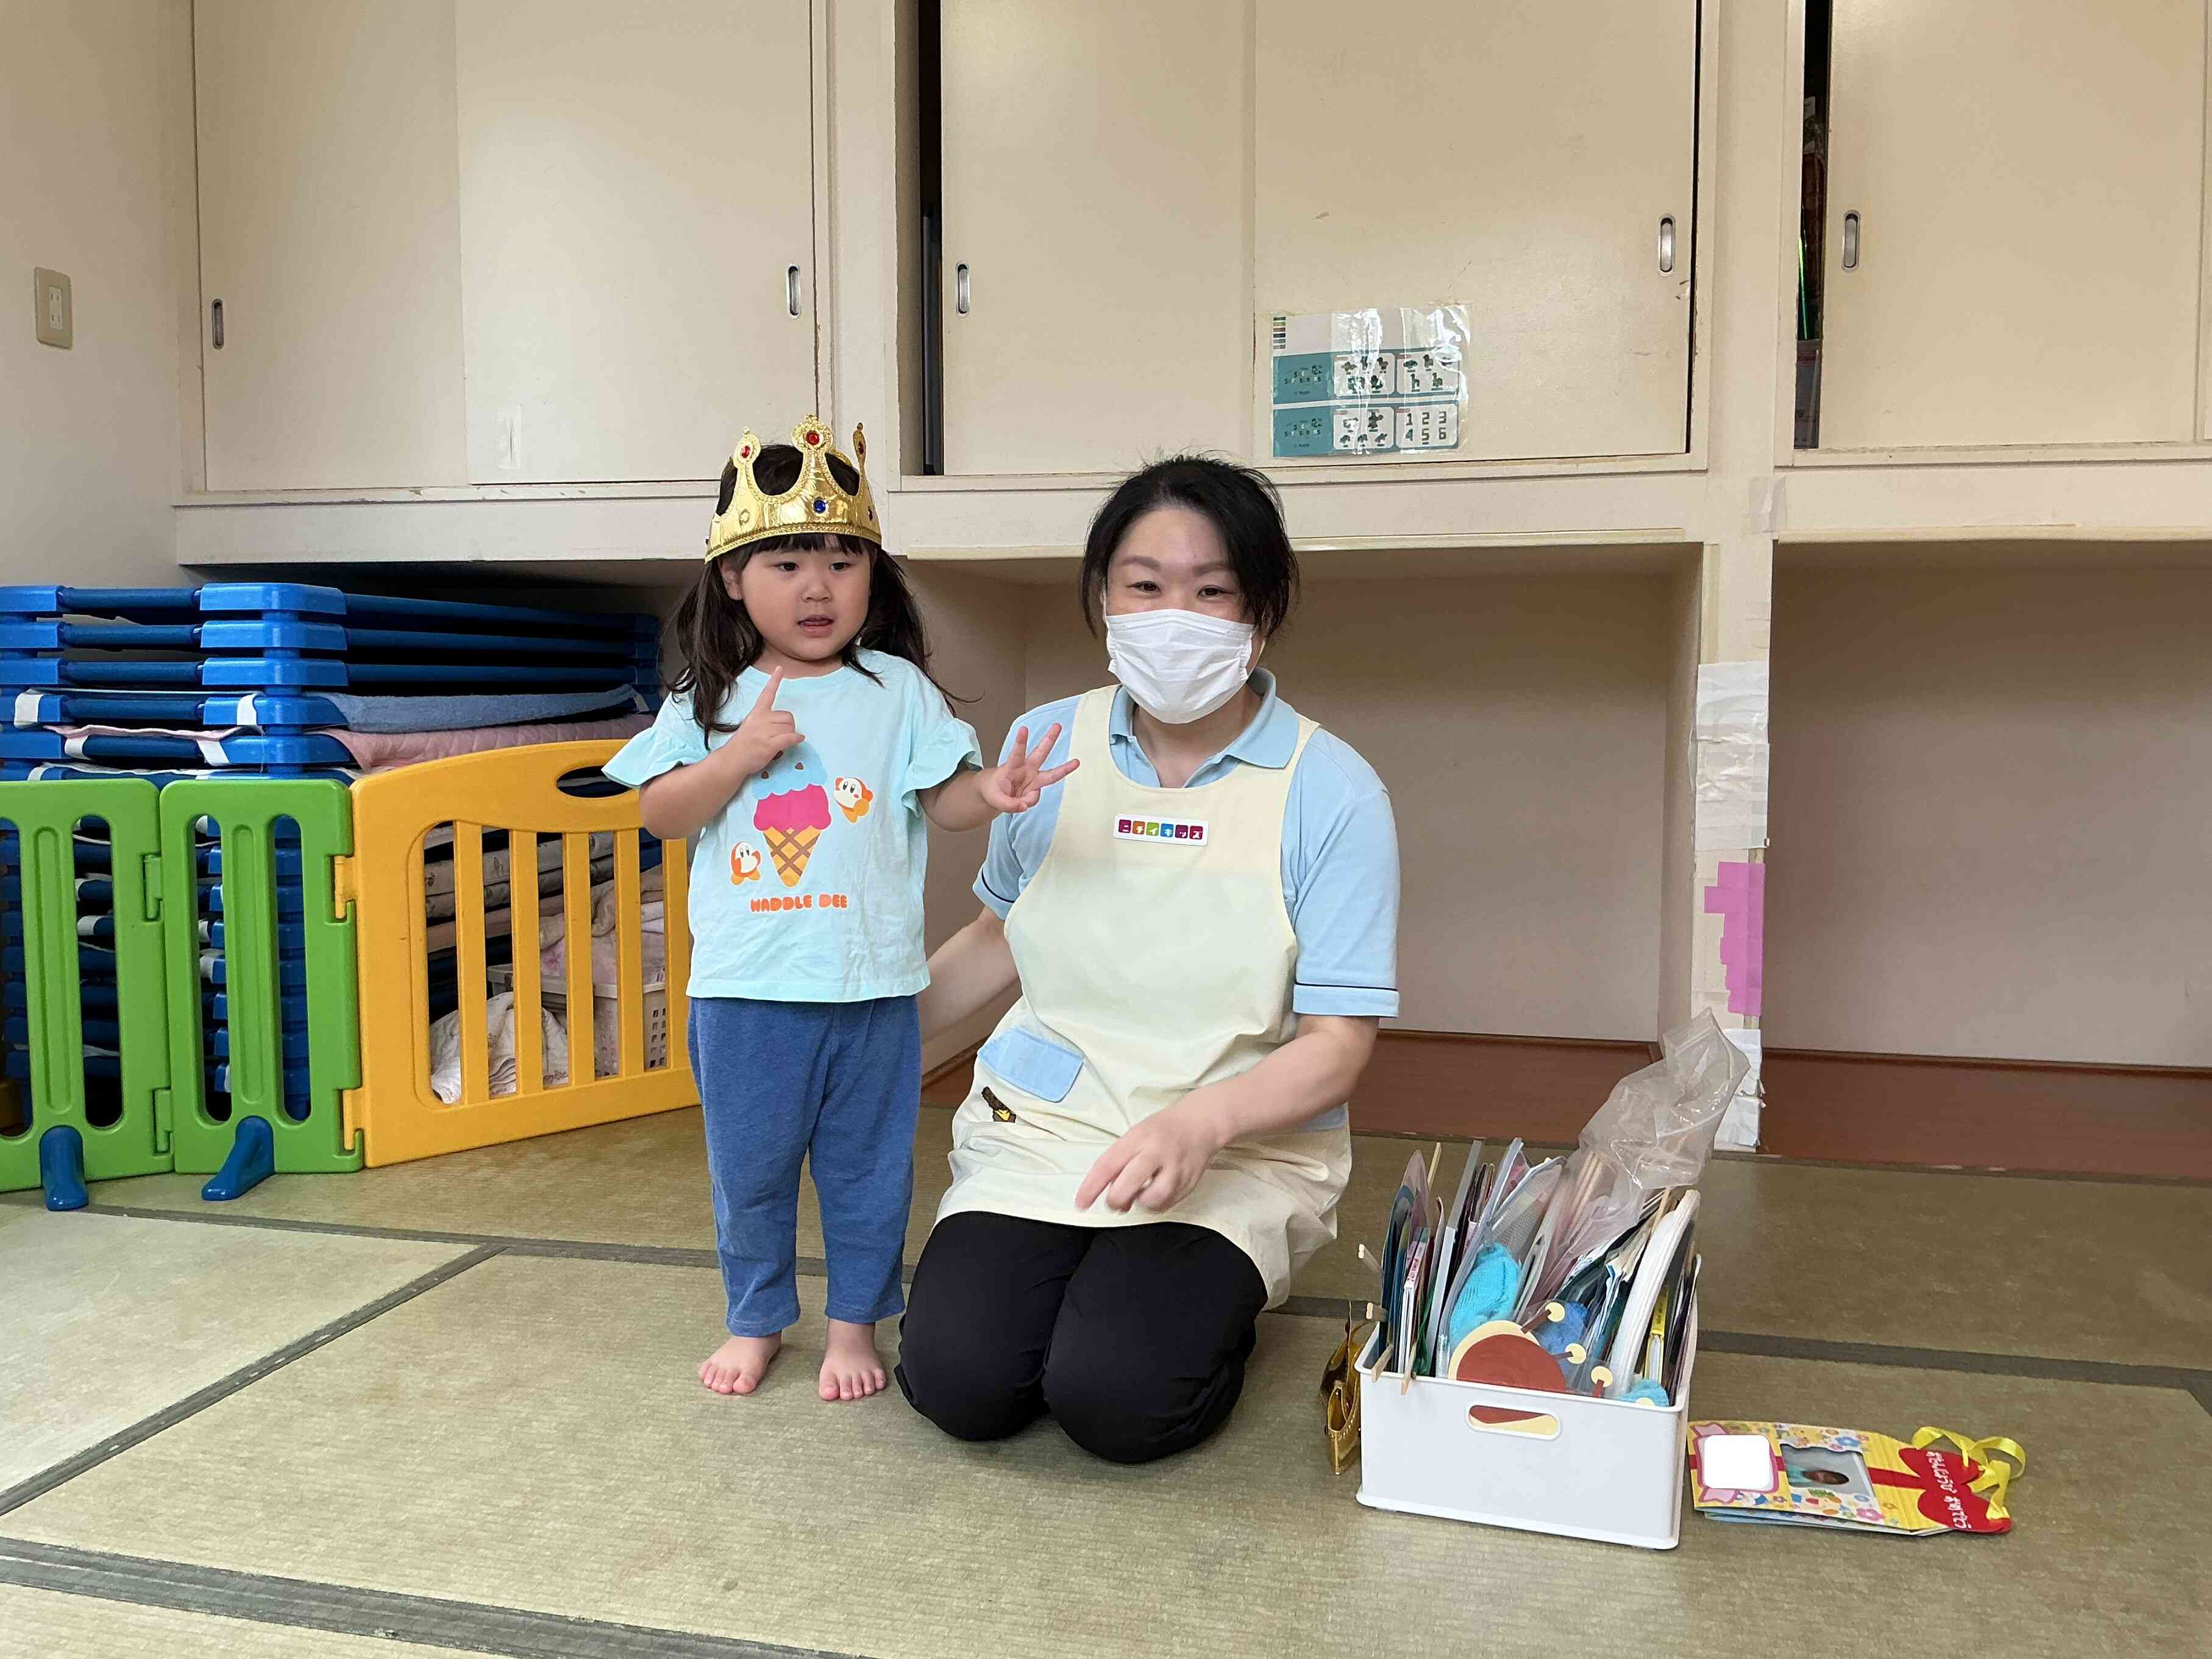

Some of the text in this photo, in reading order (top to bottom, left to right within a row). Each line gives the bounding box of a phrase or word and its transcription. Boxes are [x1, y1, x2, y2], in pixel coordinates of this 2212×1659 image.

[1406, 411, 1446, 425] 1 2 3
[1406, 427, 1446, 441] 4 5 6
[1120, 821, 1203, 839] ニチイキッズ
[750, 893, 848, 912] WADDLE DEE
